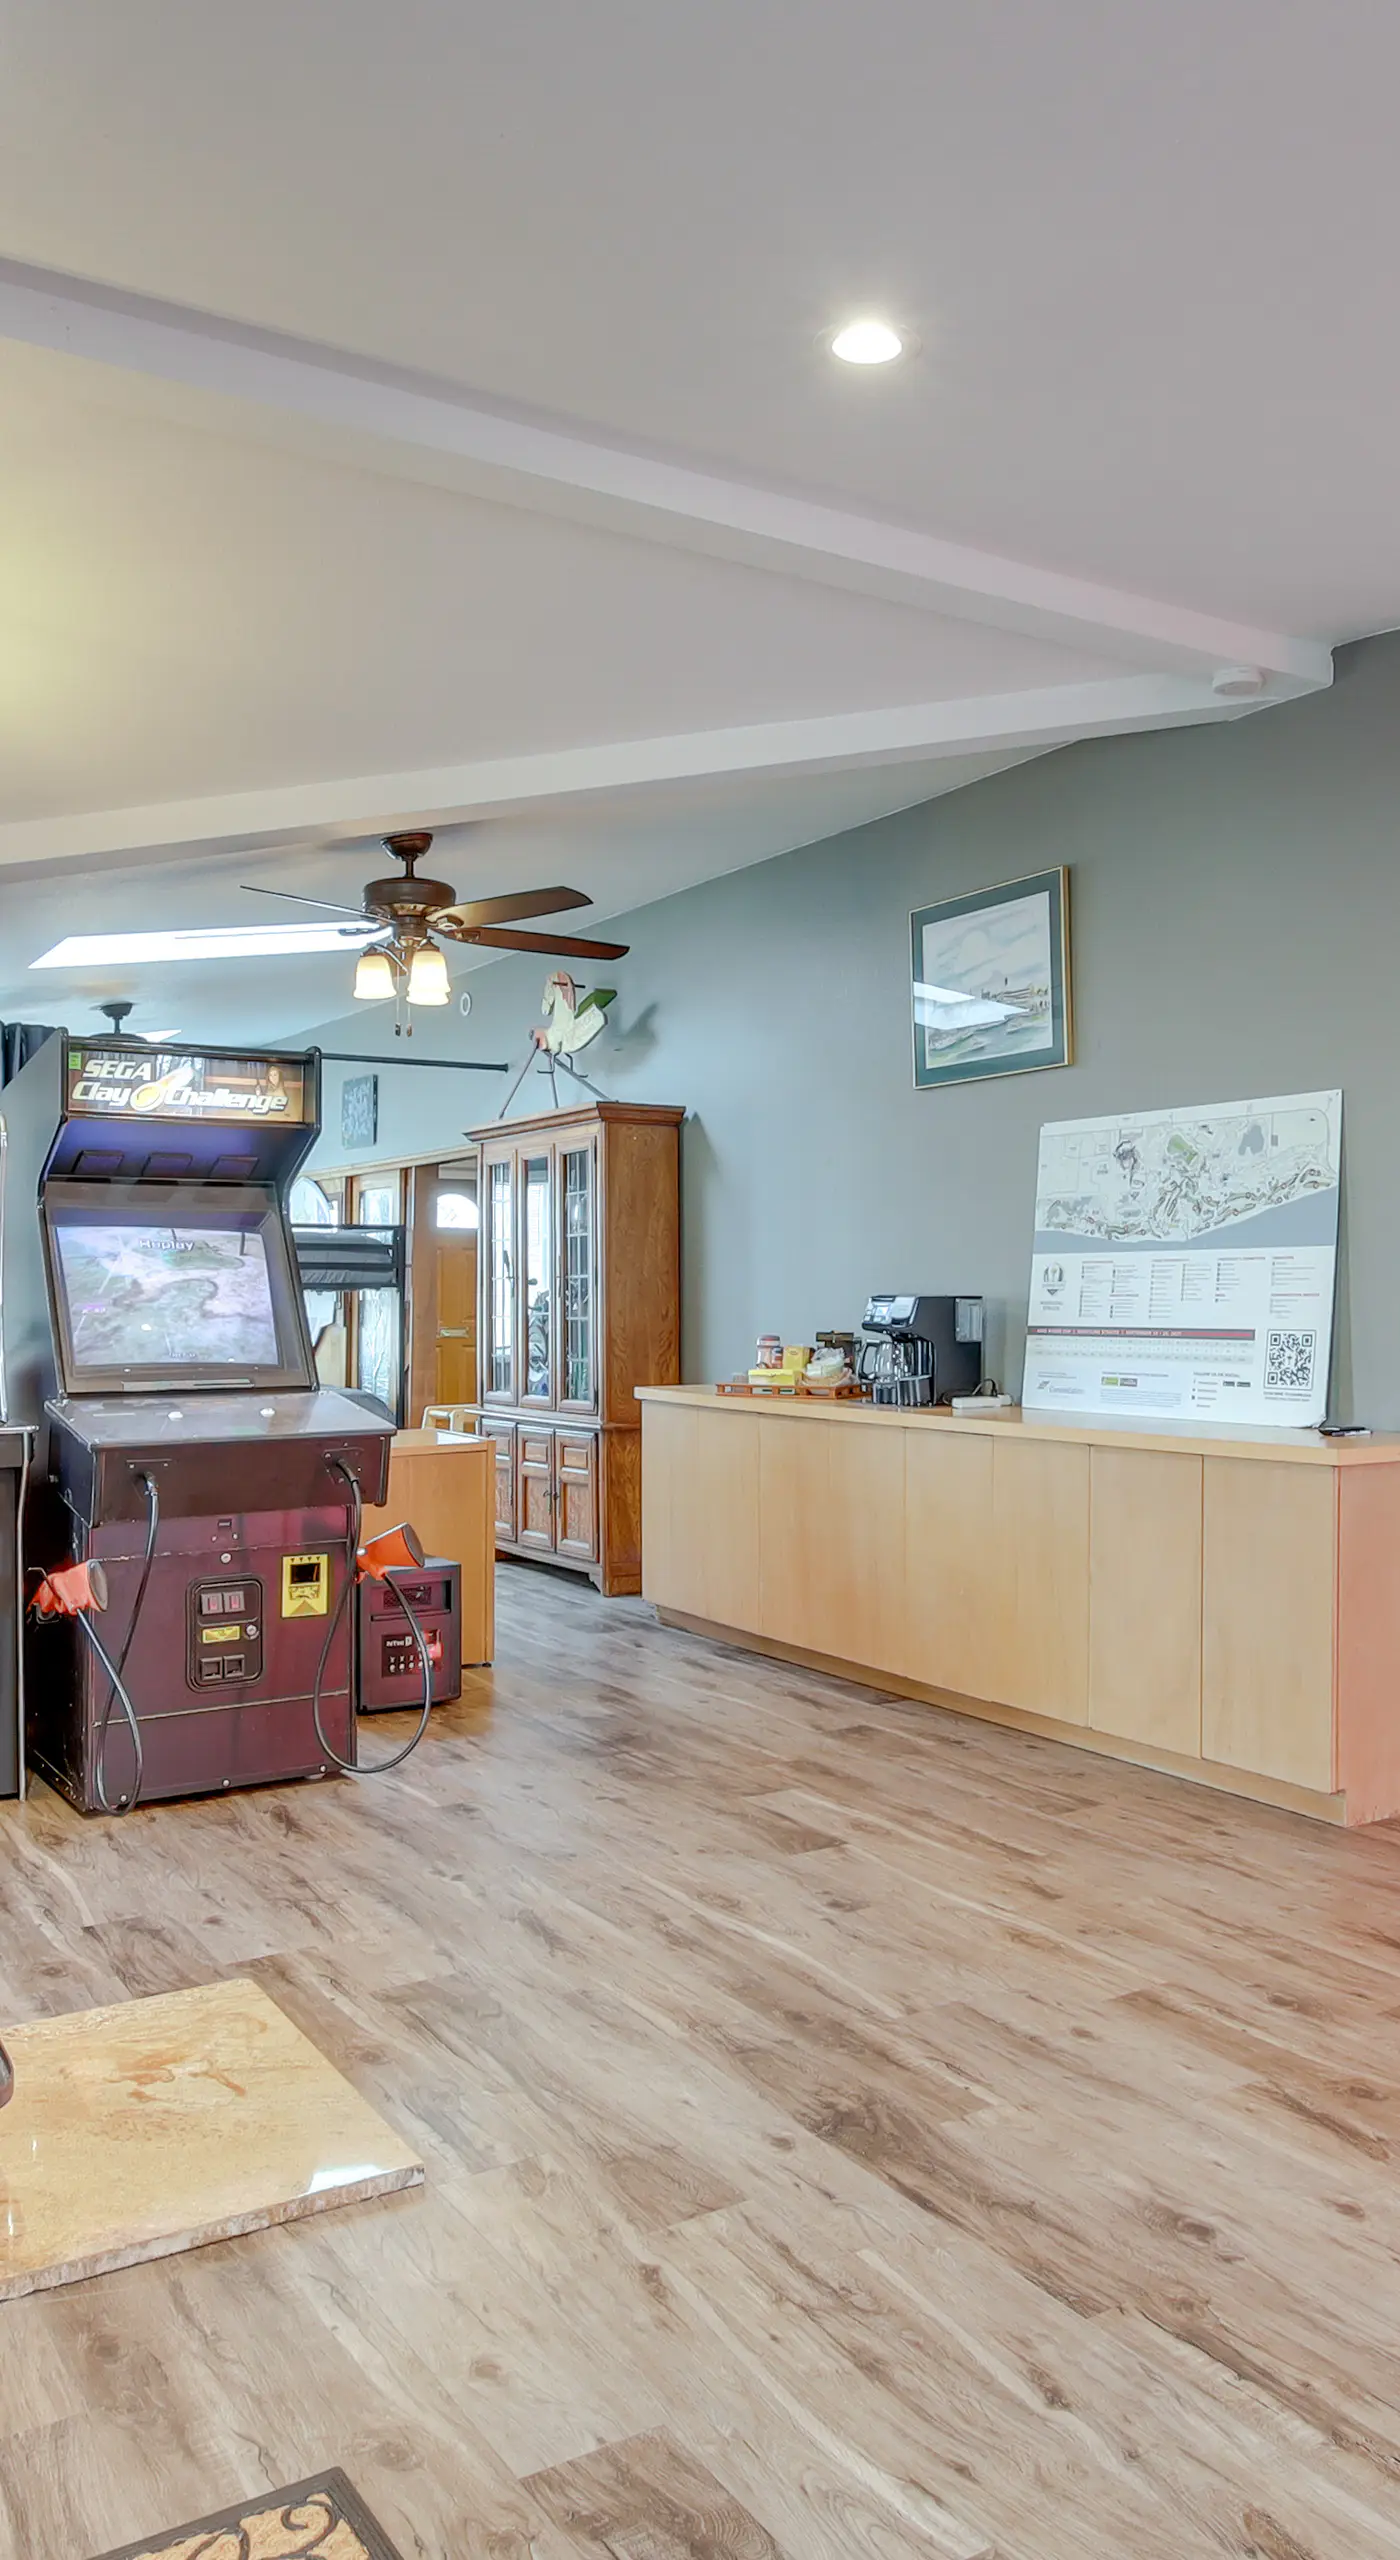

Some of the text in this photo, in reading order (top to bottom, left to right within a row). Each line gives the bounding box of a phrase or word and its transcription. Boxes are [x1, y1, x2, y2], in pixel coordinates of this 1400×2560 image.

[82, 1059, 152, 1081] SEGA
[71, 1080, 288, 1114] Clay Challenge
